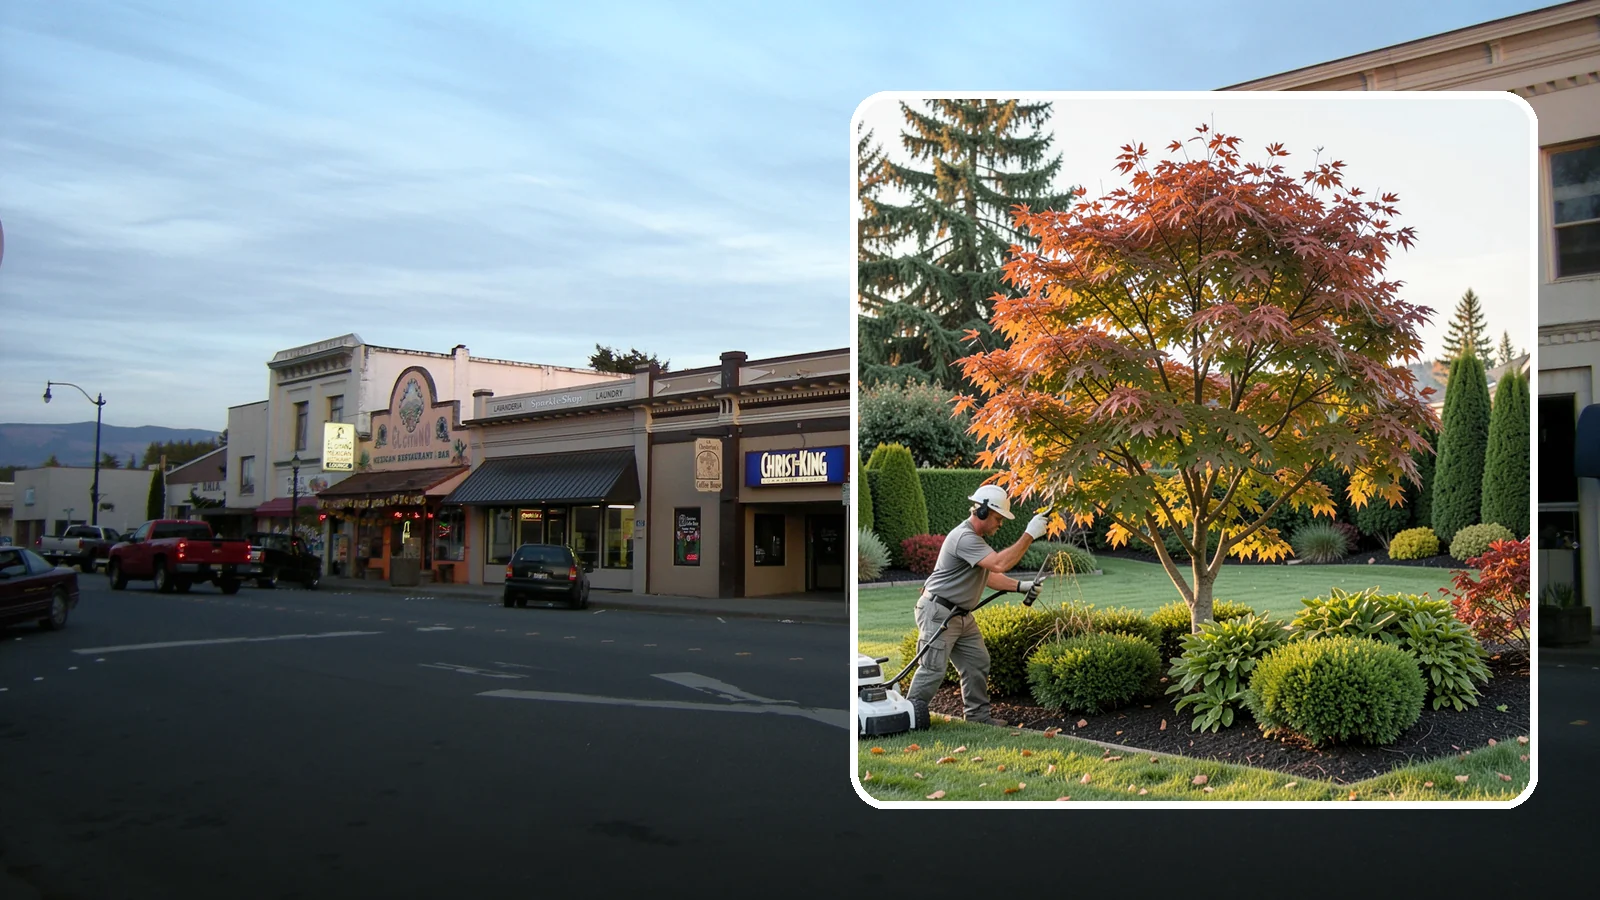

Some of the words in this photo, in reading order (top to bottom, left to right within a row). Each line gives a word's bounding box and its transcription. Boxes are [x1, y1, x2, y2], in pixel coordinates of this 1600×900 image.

[530, 396, 561, 409] Sparkle
[561, 394, 582, 404] Shop
[595, 389, 624, 400] LAUNDRY
[493, 402, 523, 412] LAVANDERIA
[392, 425, 402, 449] EL
[373, 455, 396, 464] MEXICAN
[397, 451, 433, 462] RESTAURANT
[437, 450, 450, 459] BAR
[761, 451, 797, 478] CHRIST
[799, 449, 827, 476] KING
